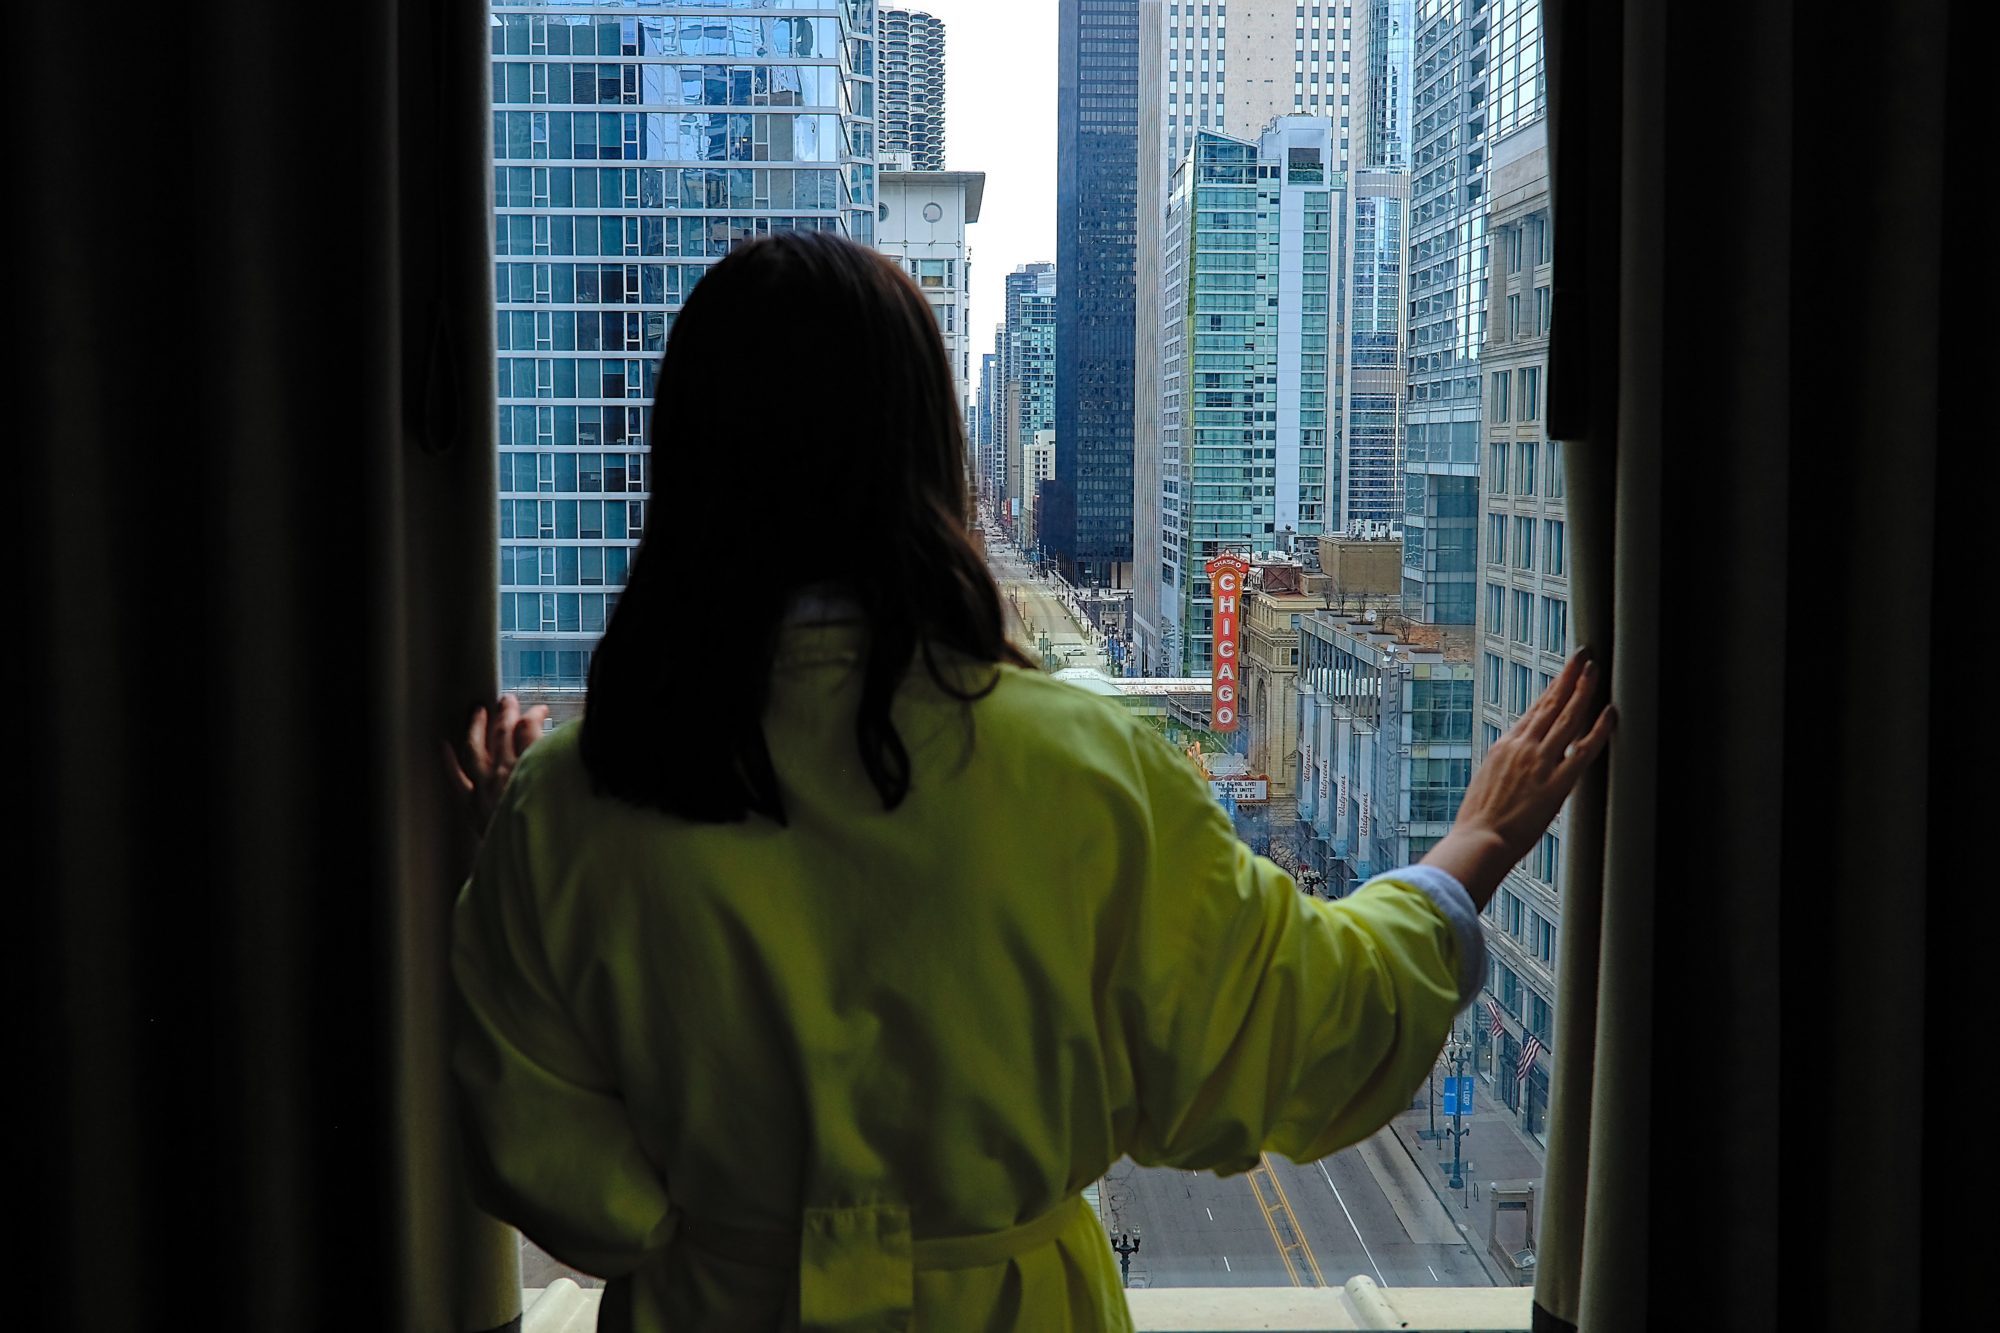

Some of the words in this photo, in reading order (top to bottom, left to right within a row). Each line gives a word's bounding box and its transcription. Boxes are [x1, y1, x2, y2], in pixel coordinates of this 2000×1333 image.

[1213, 559, 1236, 568] CHASE
[1216, 573, 1236, 724] CHICAGO
[1388, 671, 1398, 742] BALLET
[1303, 744, 1313, 783] Walgreens
[1320, 759, 1330, 799] Walgreens
[1338, 775, 1348, 817] Walgreens
[1384, 750, 1397, 834] JOFFREY
[1360, 792, 1371, 837] Walgreens
